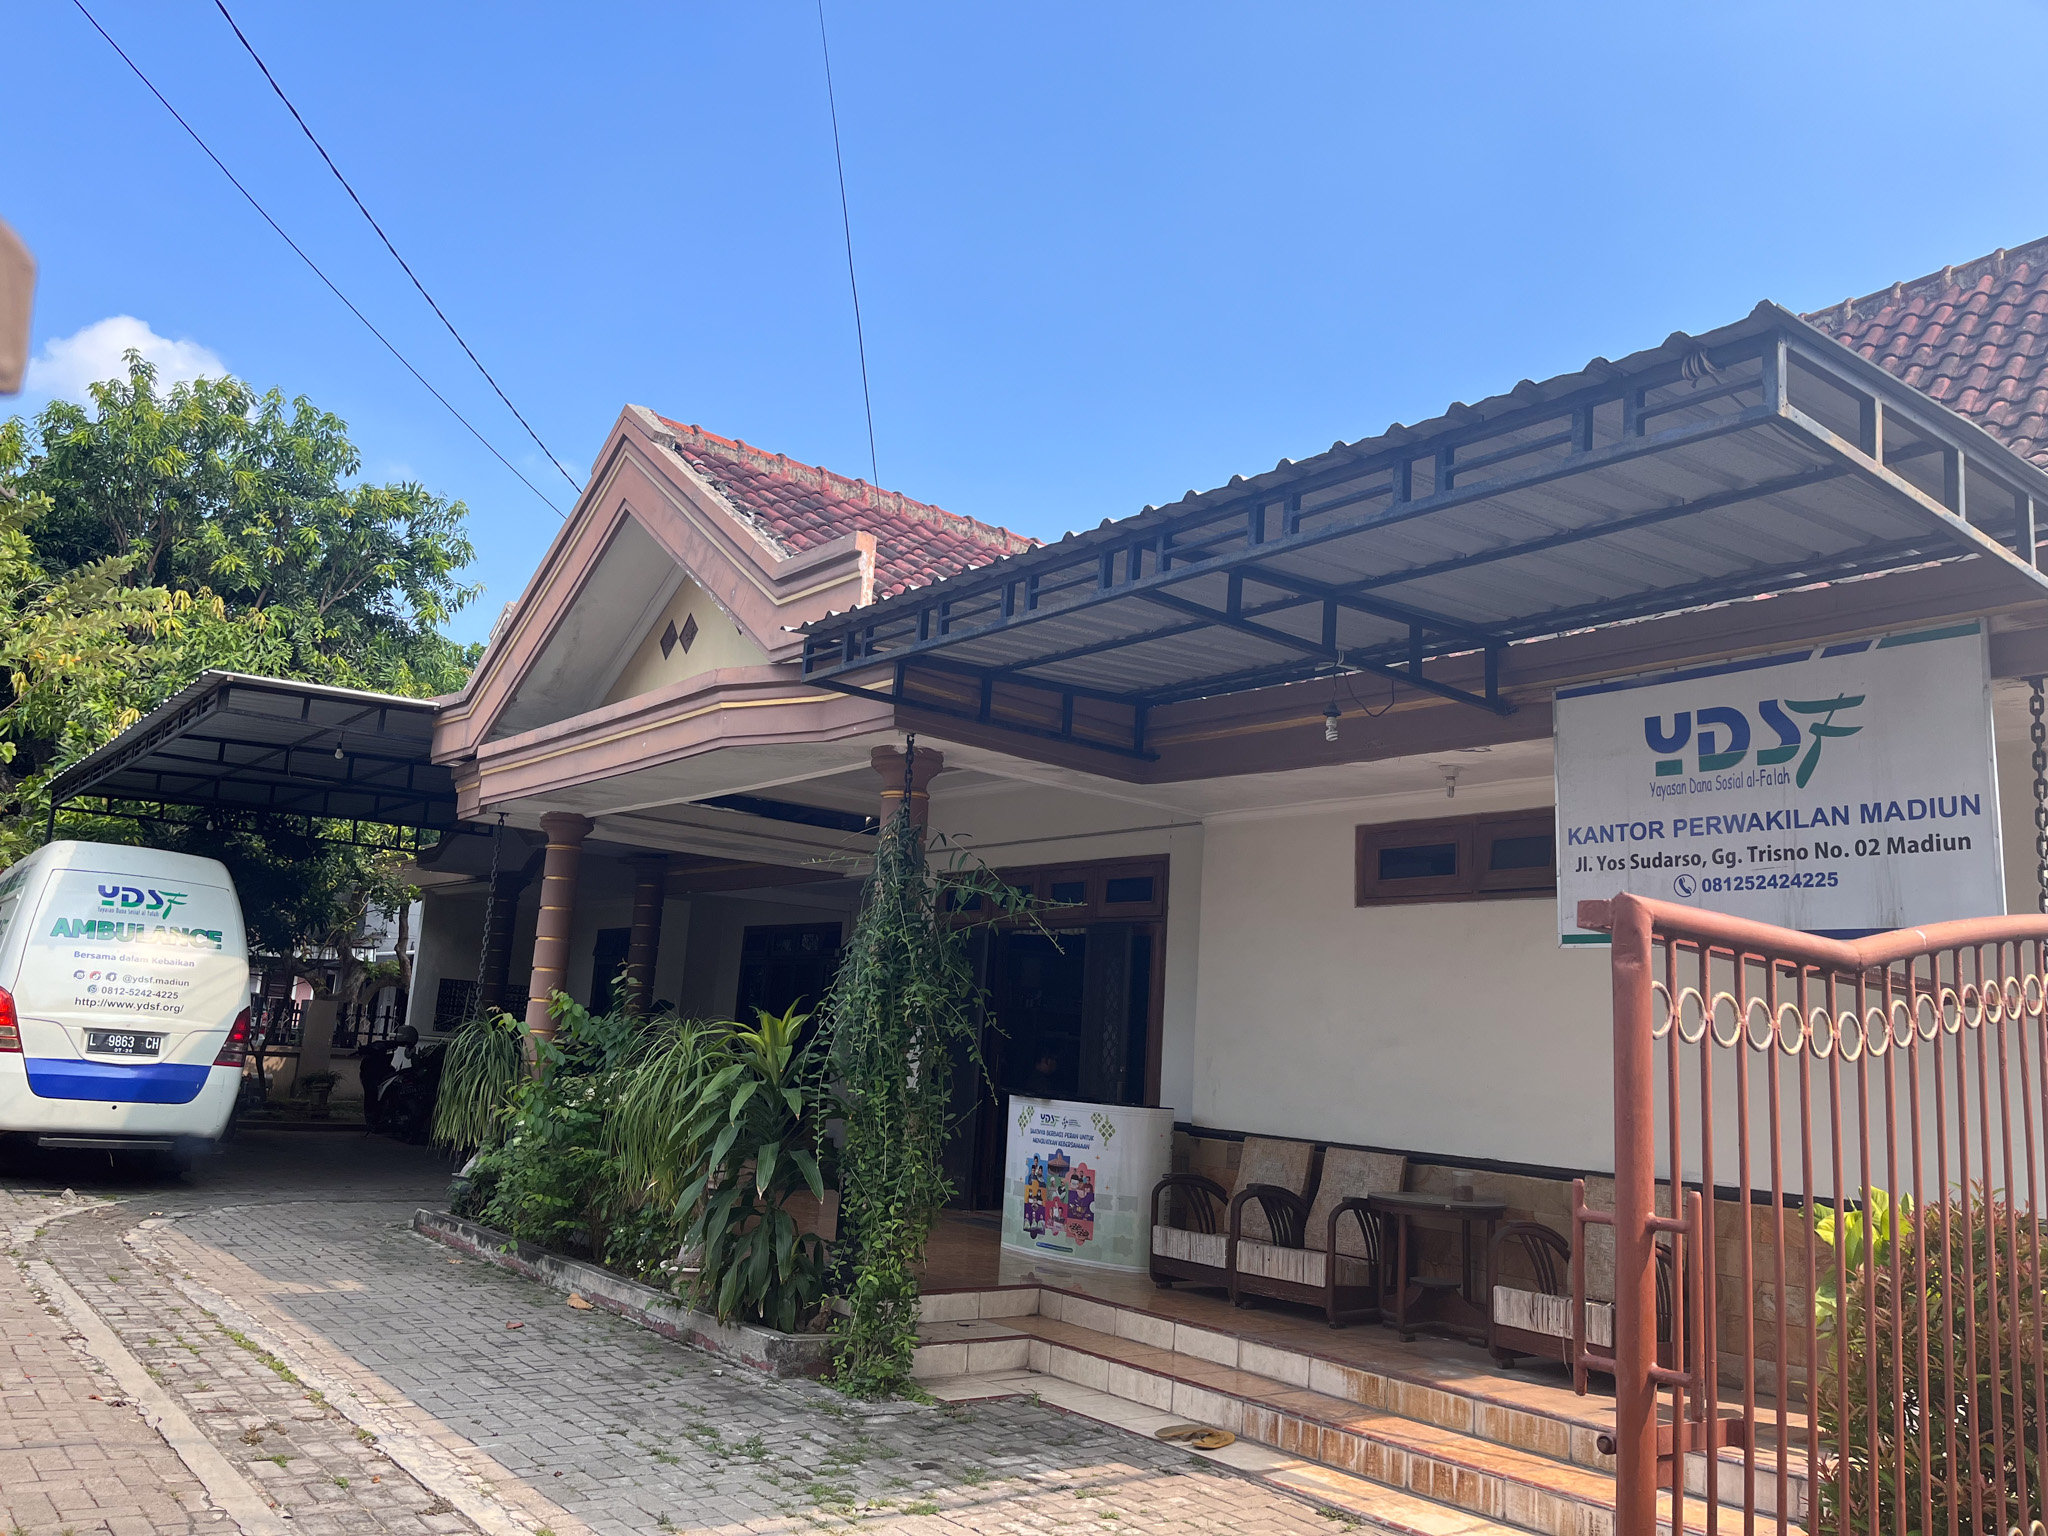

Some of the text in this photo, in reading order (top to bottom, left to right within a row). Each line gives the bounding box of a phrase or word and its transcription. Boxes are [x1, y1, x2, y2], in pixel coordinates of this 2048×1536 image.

[1650, 781, 1687, 801] Yayasan
[1689, 775, 1712, 794] Dana
[1715, 771, 1744, 790] Sosial
[1568, 793, 1981, 846] KANTOR PERWAKILAN MADIUN
[1575, 833, 1972, 873] Jl. Yos Sudarso, Gg. Trisno No. 02 Madiun
[1701, 871, 1839, 893] 081252424225
[50, 918, 223, 950] AMBULANCE
[74, 951, 195, 967] Bersama dalam Kebaikan
[122, 974, 190, 987] @ydsf.madiun
[101, 986, 179, 999] 0812-5242-4225
[74, 997, 184, 1014] http://www.ydsf.org/
[89, 1034, 159, 1050] L 9863 CH
